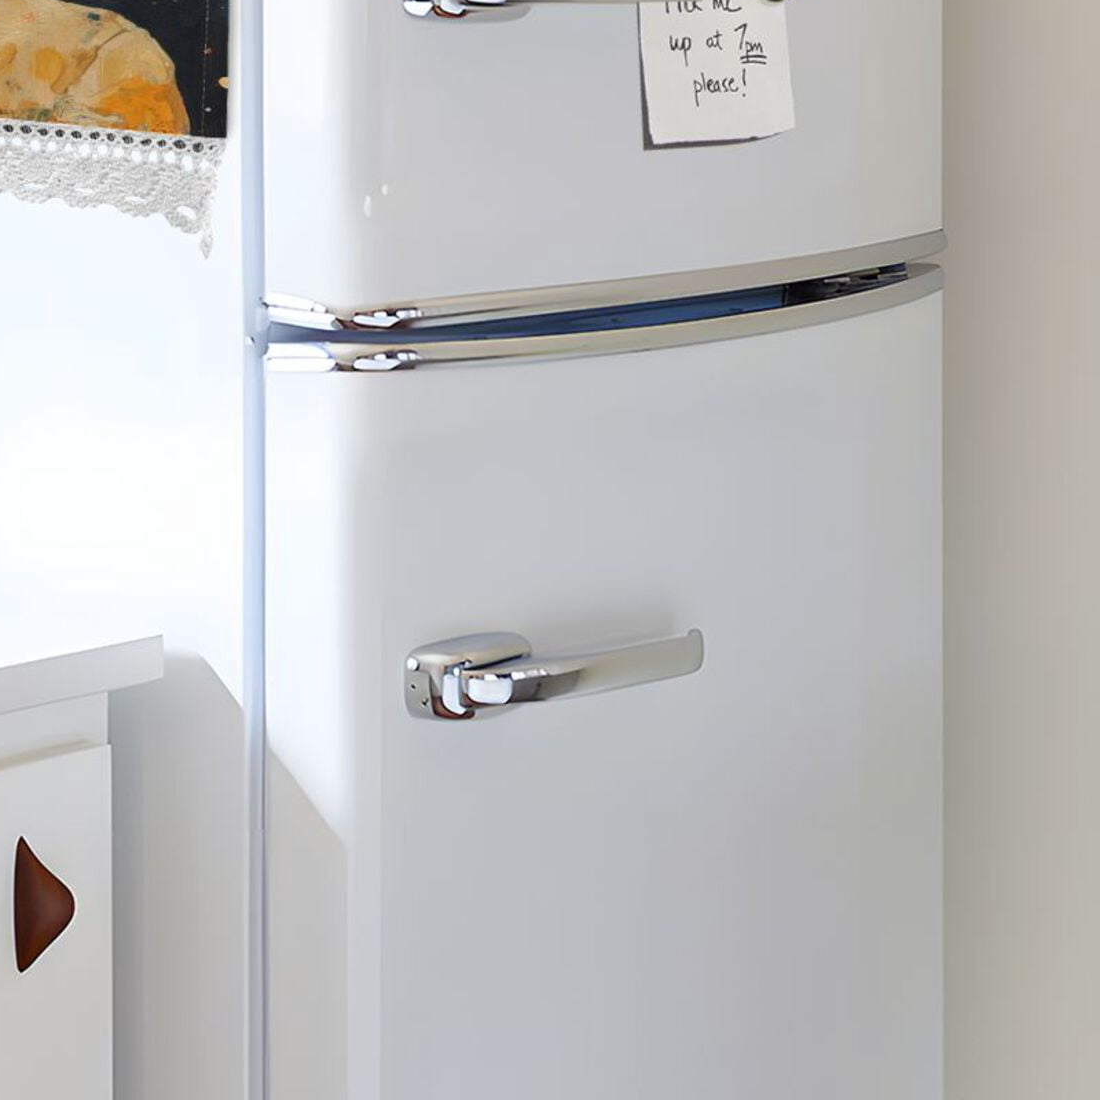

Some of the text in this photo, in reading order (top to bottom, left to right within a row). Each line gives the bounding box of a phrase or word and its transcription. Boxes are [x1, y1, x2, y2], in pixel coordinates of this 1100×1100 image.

[669, 35, 692, 66] up
[706, 30, 723, 50] at
[693, 68, 746, 107] please!
